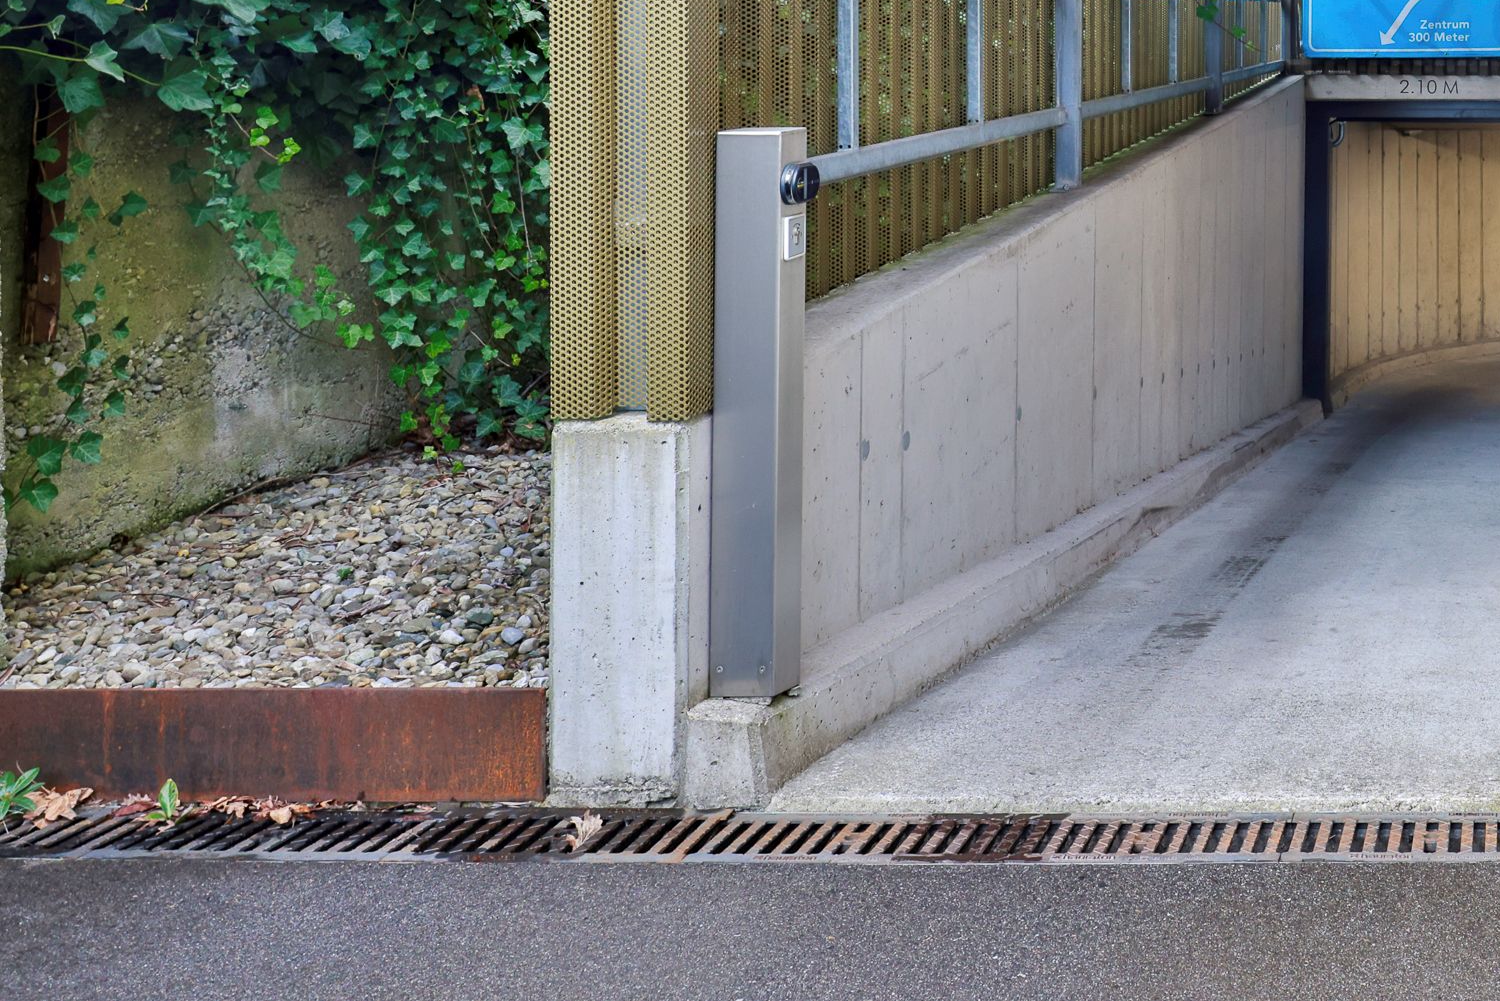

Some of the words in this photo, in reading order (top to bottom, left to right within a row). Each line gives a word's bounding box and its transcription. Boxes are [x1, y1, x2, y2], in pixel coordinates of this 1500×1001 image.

[1420, 19, 1470, 29] Zentrum
[1408, 32, 1430, 42] 300
[1434, 32, 1470, 42] Meter
[1399, 79, 1437, 94] 2.10
[1443, 80, 1459, 94] M
